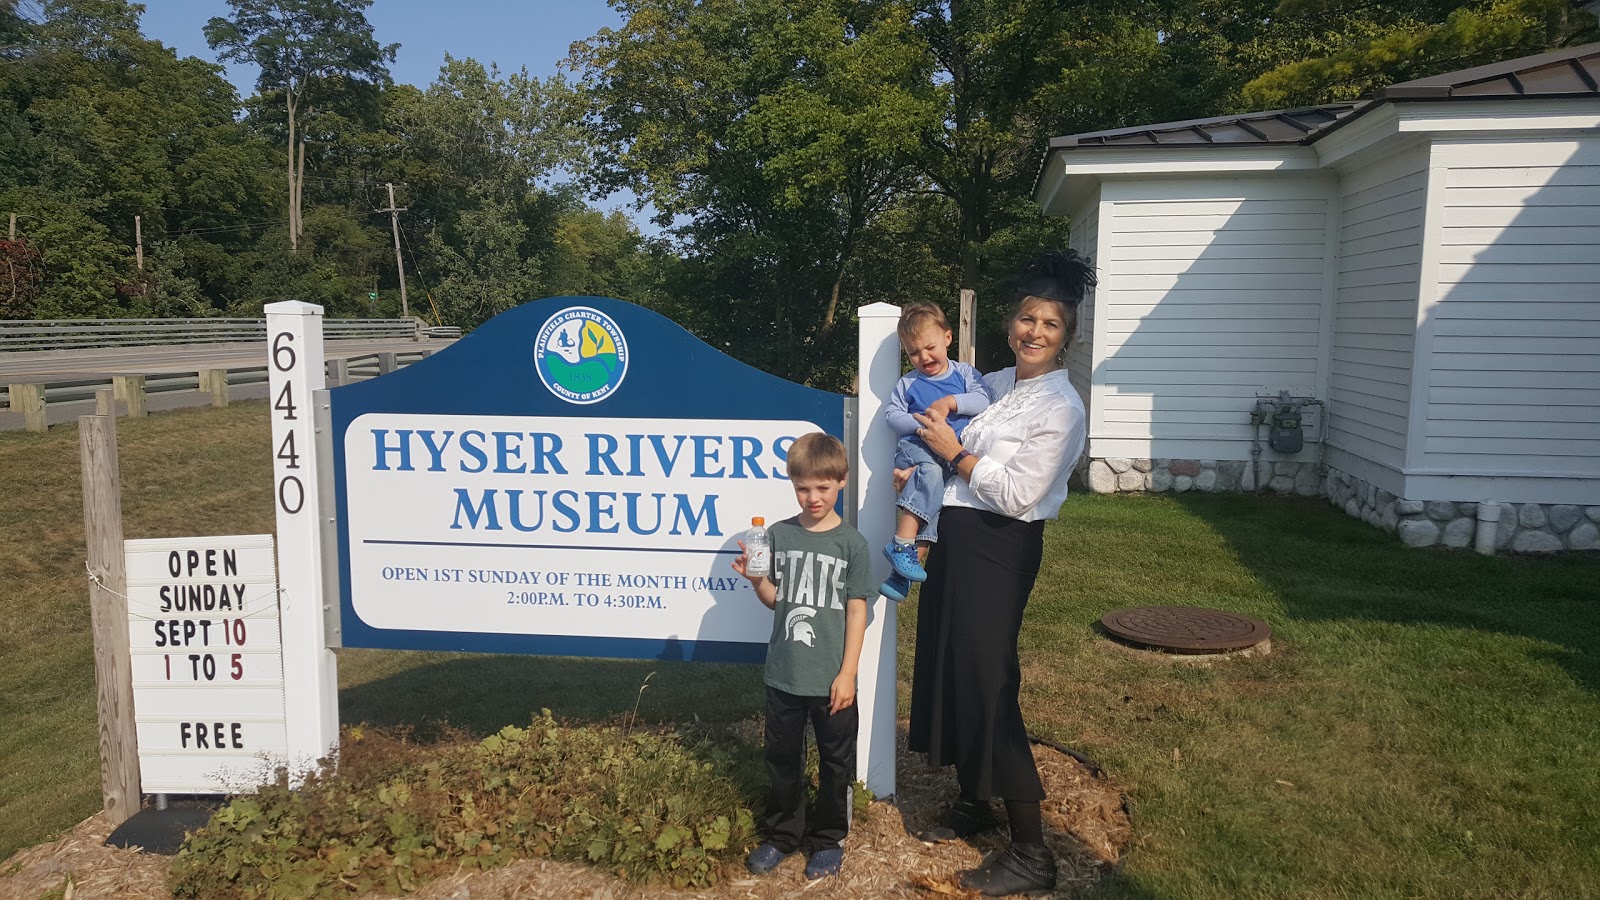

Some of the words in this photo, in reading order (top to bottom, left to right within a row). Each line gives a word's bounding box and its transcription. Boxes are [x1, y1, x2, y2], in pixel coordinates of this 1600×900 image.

[538, 317, 564, 359] PLAINFIELD
[565, 311, 601, 324] CHARTER
[602, 321, 625, 362] TOWNSHIP
[553, 382, 580, 399] COUNTY
[581, 392, 591, 400] OF
[592, 384, 610, 398] KENT
[272, 331, 304, 514] 6440
[370, 428, 568, 475] HYSER
[584, 433, 799, 481] RIVERS
[449, 487, 724, 537] MUSEUM
[168, 549, 237, 578] OPEN
[381, 566, 428, 582] OPEN
[433, 568, 464, 583] 1ST
[468, 569, 541, 585] SUNDAY
[545, 571, 570, 586] OF
[573, 572, 612, 587] THE
[616, 574, 687, 590] MONTH
[691, 576, 739, 592] (MAY
[774, 550, 849, 611] STATE
[159, 583, 246, 612] SUNDAY
[506, 591, 570, 606] 2:00P.M.
[573, 593, 599, 607] TO
[603, 595, 667, 610] 4:30P.M.
[154, 619, 211, 648] SEPT
[223, 618, 247, 647] 10
[164, 653, 171, 680] 1
[187, 653, 216, 680] TO
[231, 653, 244, 680] 5
[180, 722, 244, 749] FREE
